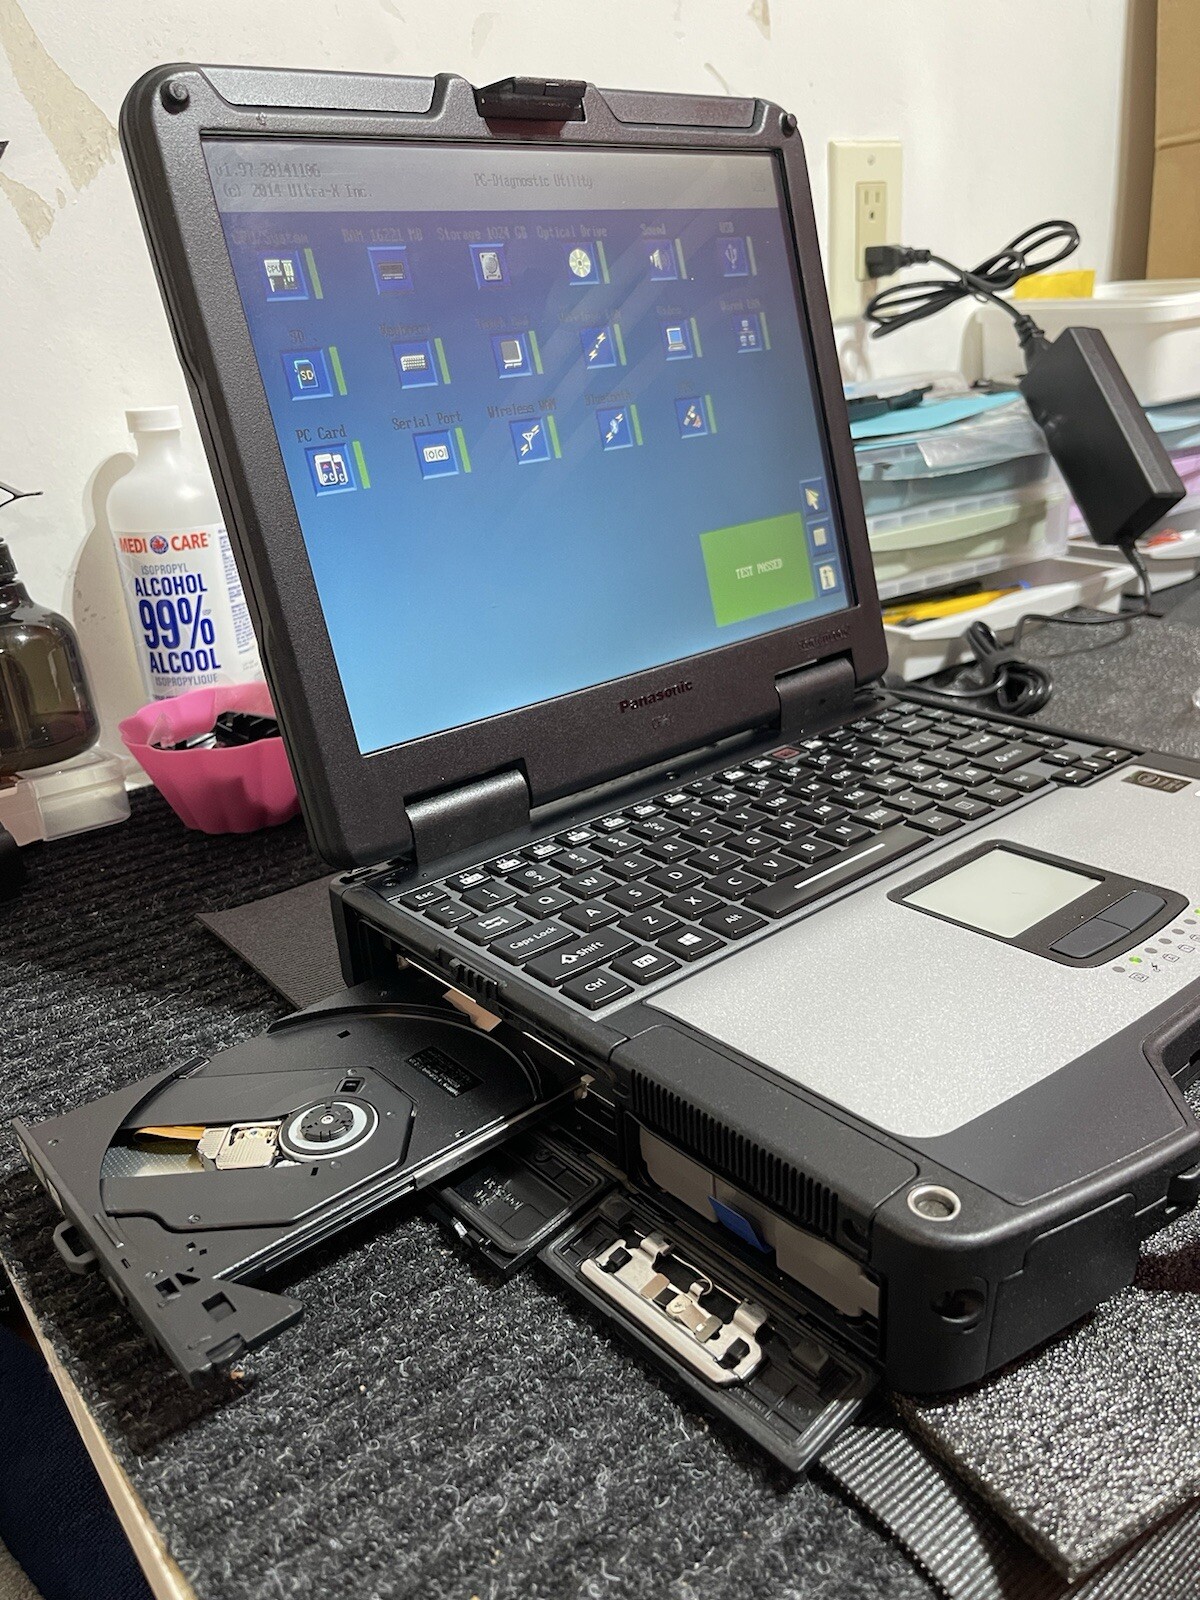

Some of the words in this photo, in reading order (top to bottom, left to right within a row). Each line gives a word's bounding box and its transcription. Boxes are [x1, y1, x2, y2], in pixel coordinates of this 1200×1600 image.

[473, 172, 550, 189] PC-Diagnostic
[554, 173, 594, 189] Utility
[252, 184, 282, 198] 2014
[346, 184, 374, 198] Inc.
[436, 226, 482, 241] Storage
[300, 369, 315, 381] SD
[487, 402, 535, 419] Wireless
[392, 414, 431, 431] Serial
[436, 410, 464, 426] Port
[295, 428, 312, 443] PC
[317, 425, 348, 441] Card
[119, 536, 148, 554] MEDI
[170, 532, 209, 552] CARE
[140, 562, 189, 576] ISOPROPYL
[735, 565, 753, 580] TEST
[756, 558, 783, 575] PASSED
[135, 573, 208, 597] ALCOHOL
[138, 594, 216, 650] 99%
[150, 647, 221, 675] ALCOOL
[155, 672, 218, 687] ISOPROPYLIQUE
[619, 679, 694, 714] Panasonic
[735, 812, 749, 820] Y
[780, 821, 797, 830] H
[835, 826, 852, 835] N
[746, 837, 761, 845] G
[663, 844, 678, 852] R
[801, 843, 816, 852] B
[708, 853, 721, 862] F
[623, 860, 638, 868] E
[763, 859, 779, 869] V
[668, 871, 683, 880] D
[727, 876, 743, 886] C
[579, 877, 598, 887] W
[415, 890, 435, 901] Esc
[629, 889, 643, 898] S
[538, 896, 555, 904] Q
[684, 895, 702, 906] X
[585, 908, 601, 918] A
[724, 912, 743, 925] Alt
[642, 914, 659, 925] Z
[509, 935, 534, 950] Caps
[536, 925, 558, 941] Lock
[576, 941, 604, 958] Shift
[584, 977, 607, 993] Ctrl
